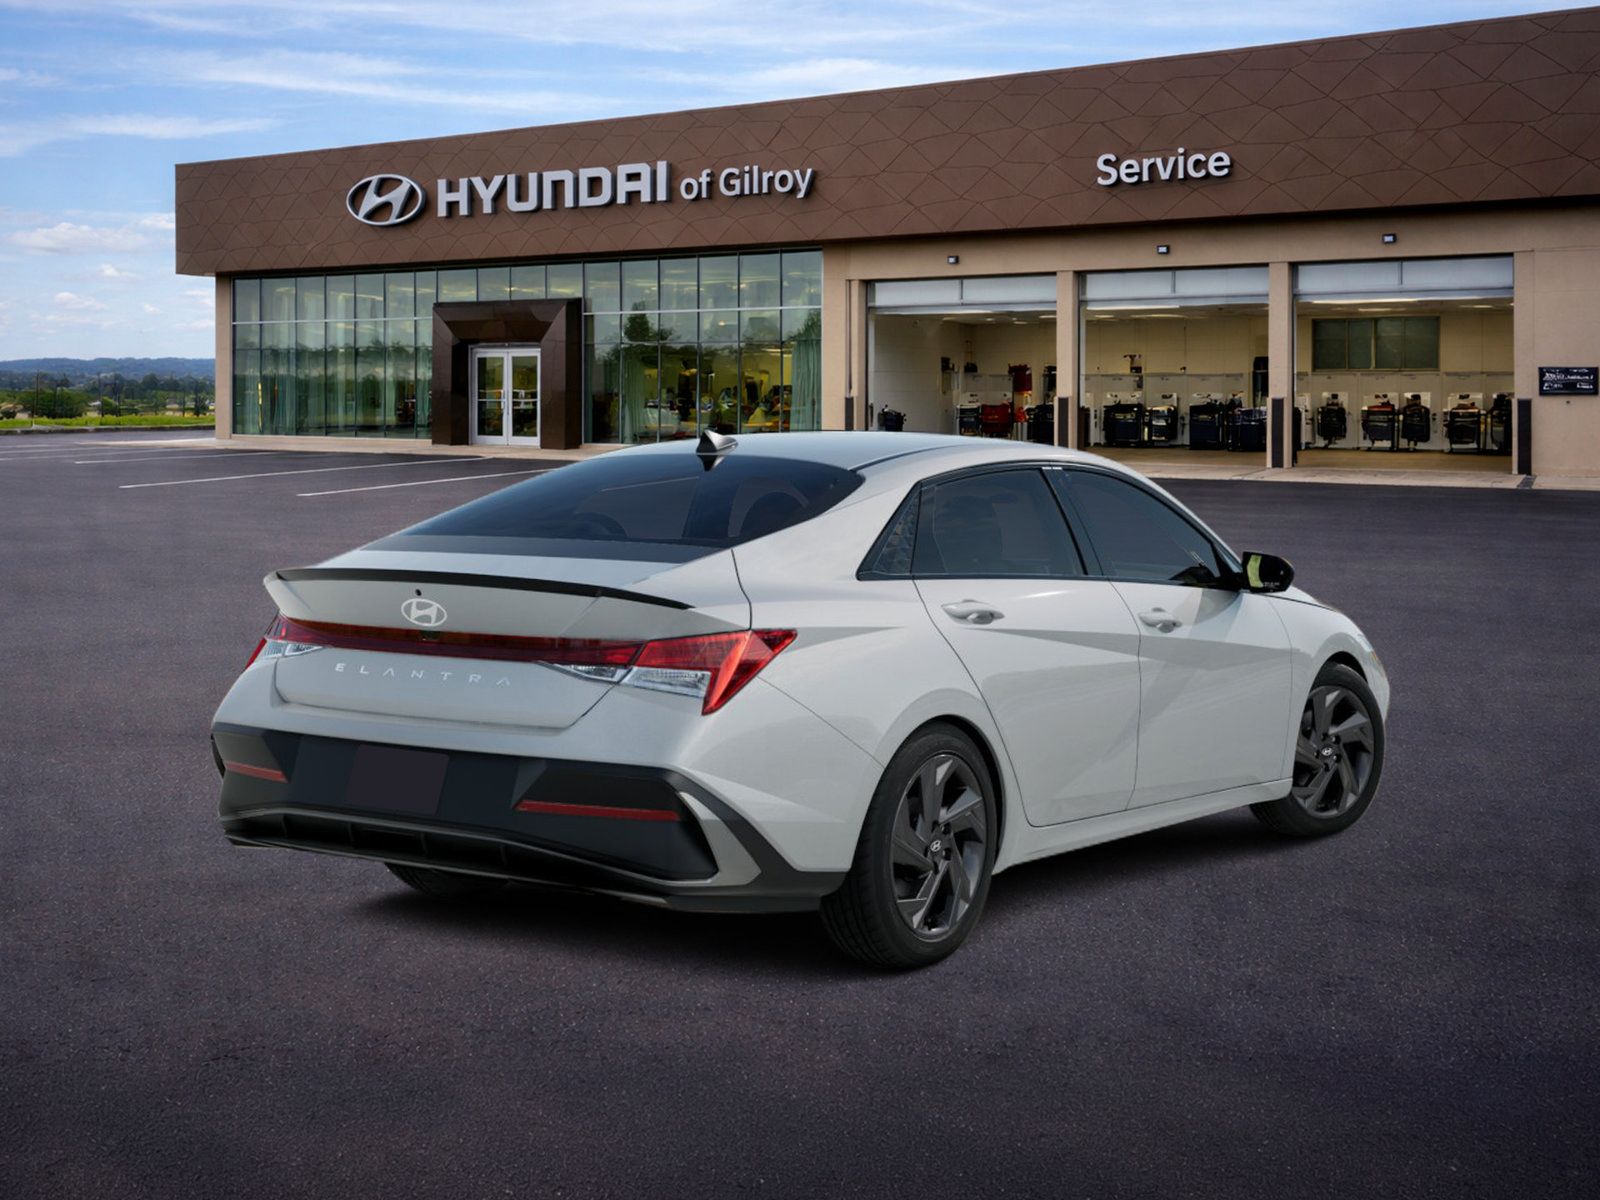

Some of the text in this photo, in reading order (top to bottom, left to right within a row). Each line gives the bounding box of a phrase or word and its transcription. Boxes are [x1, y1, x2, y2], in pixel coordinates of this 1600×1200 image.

[1096, 147, 1232, 186] Service
[436, 160, 814, 218] HYUNDAI of Gilroy
[335, 662, 511, 687] ELANTRA
